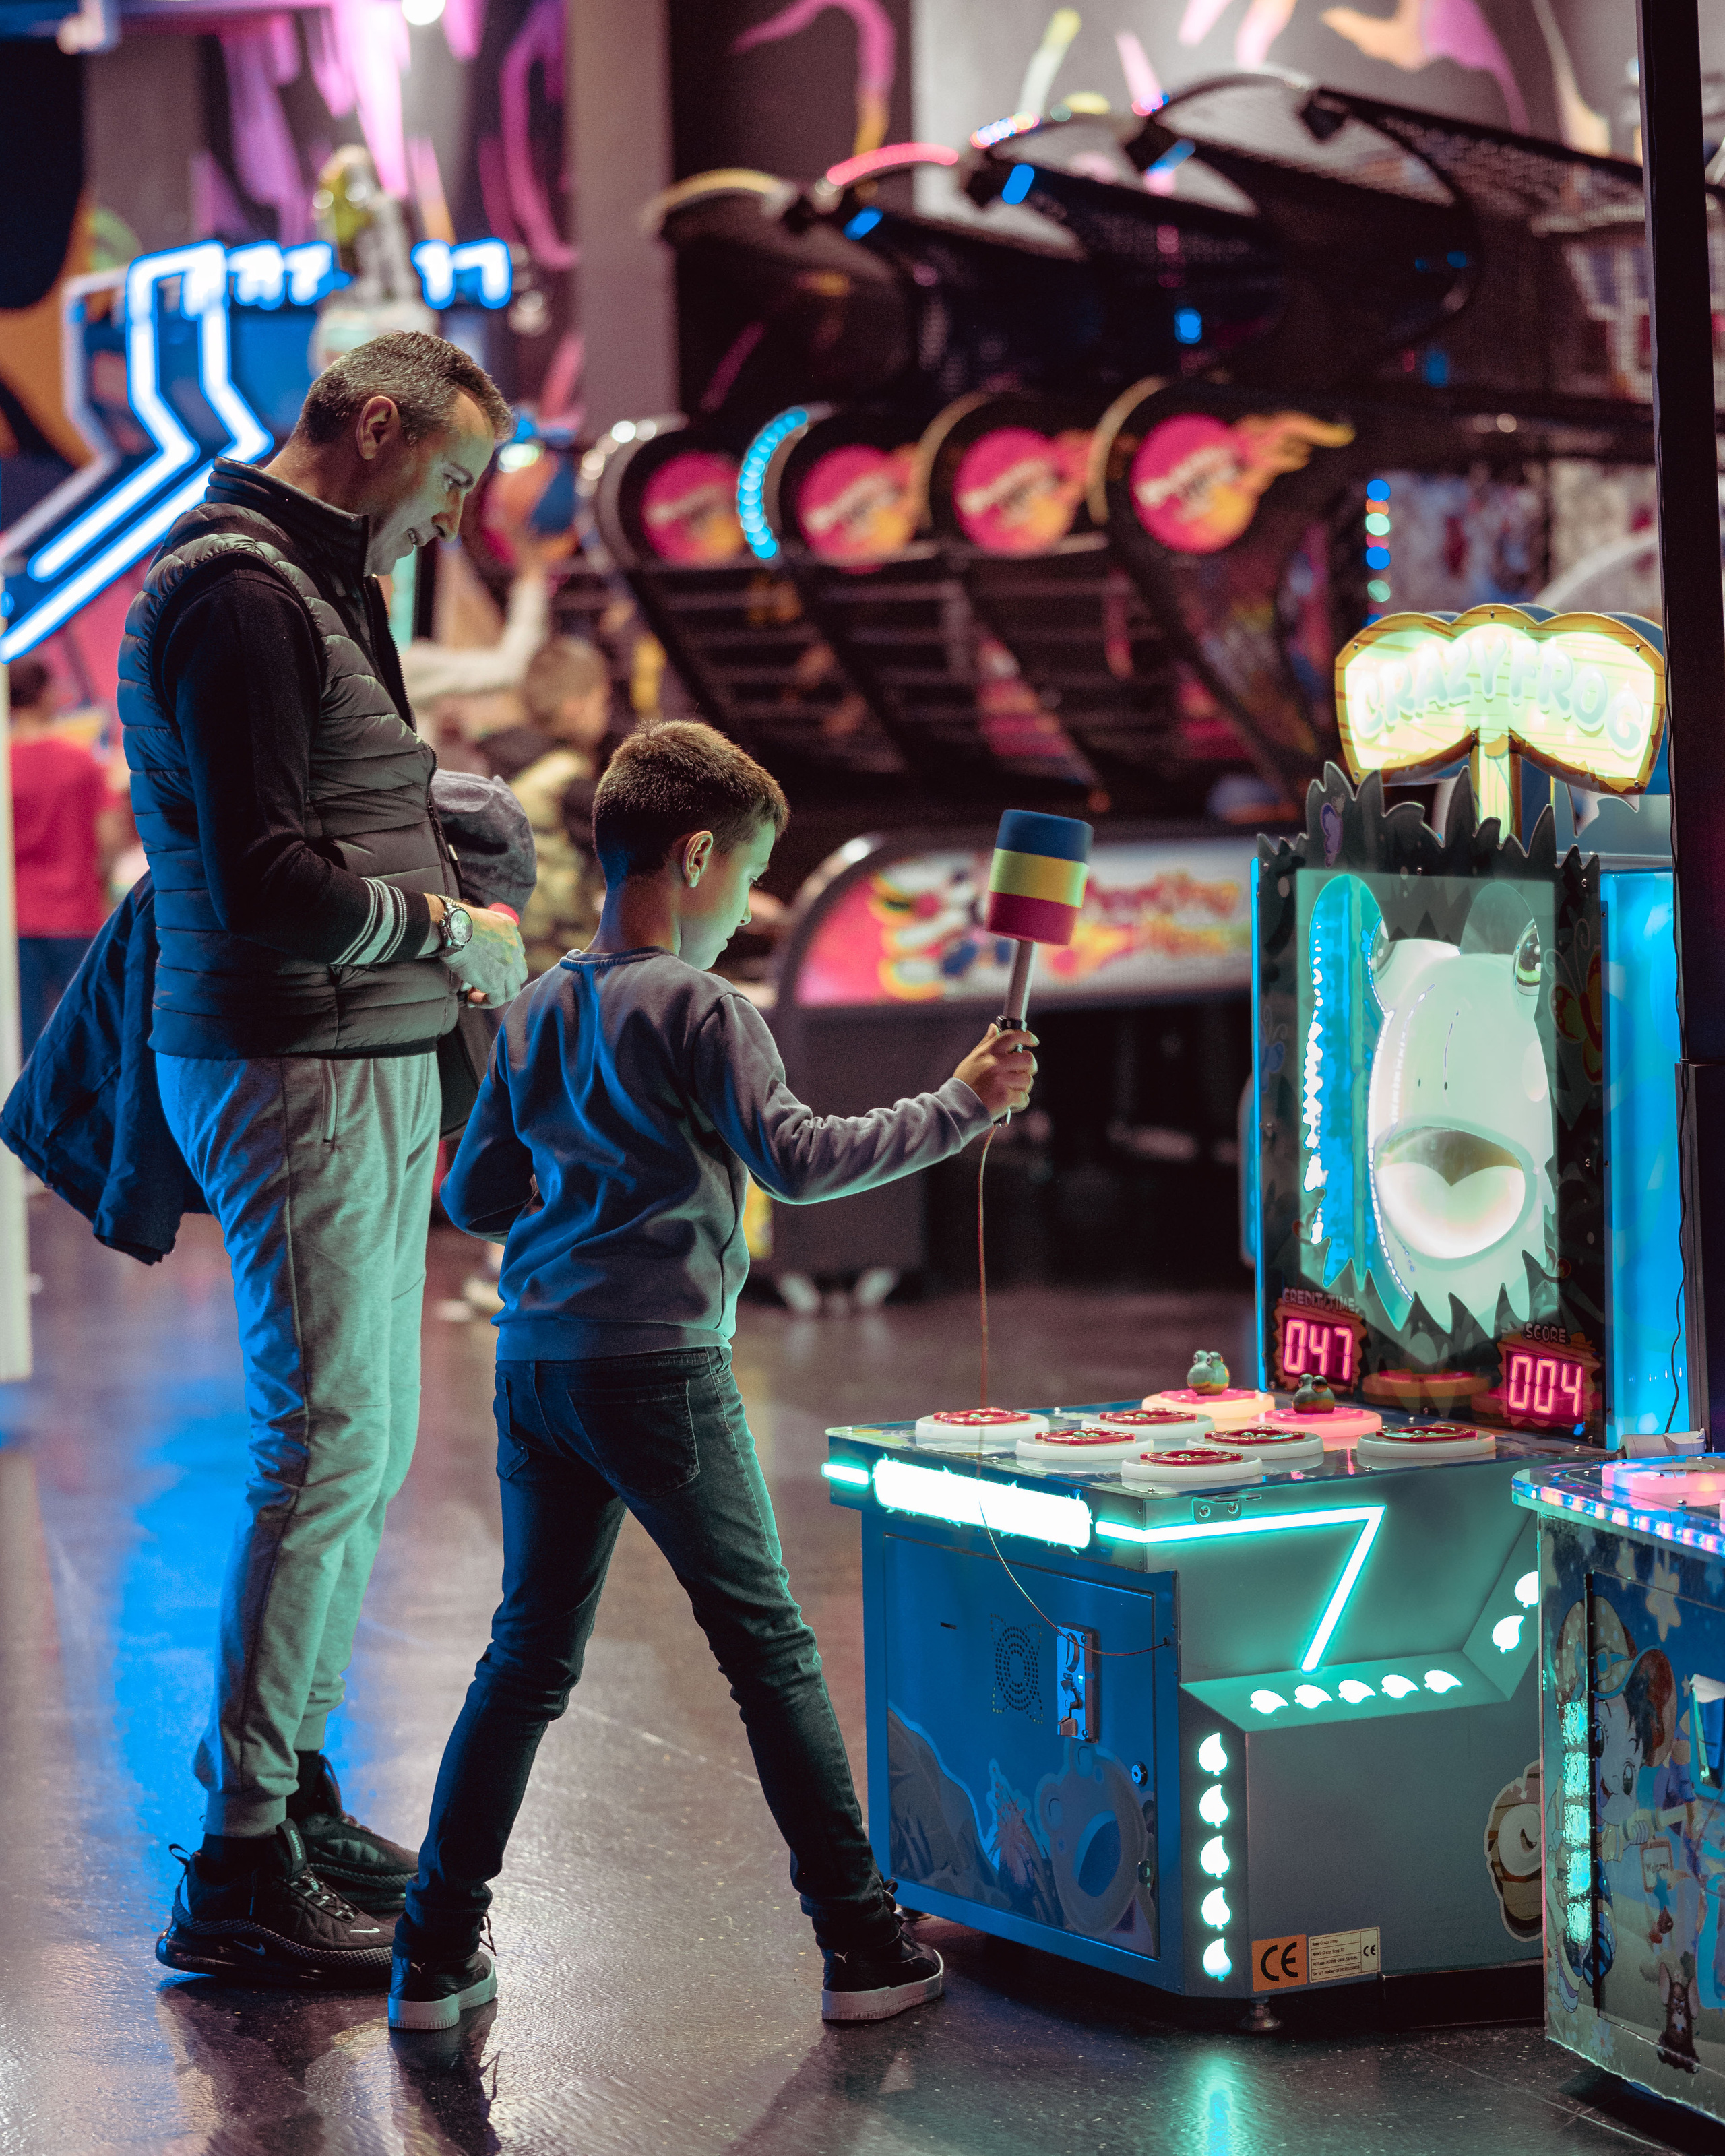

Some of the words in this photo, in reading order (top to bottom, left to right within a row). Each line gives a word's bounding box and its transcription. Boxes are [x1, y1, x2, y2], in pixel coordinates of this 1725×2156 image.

[1509, 637, 1645, 755] FROG
[1284, 1319, 1352, 1381] 047
[1524, 1322, 1567, 1343] SCORE
[1509, 1354, 1583, 1416] 004
[1260, 1942, 1298, 1982] CE
[1363, 1944, 1376, 1957] CE
